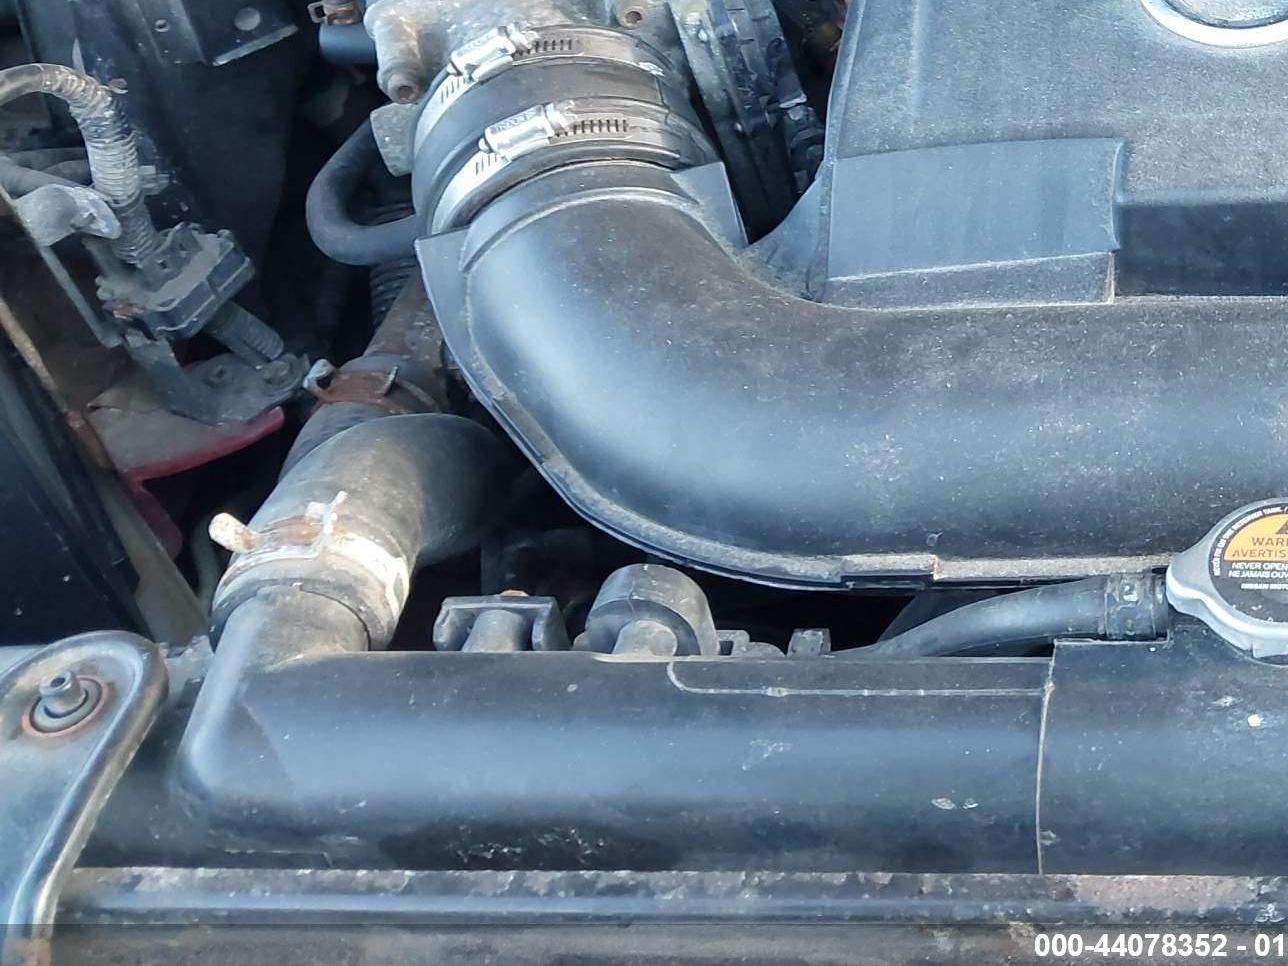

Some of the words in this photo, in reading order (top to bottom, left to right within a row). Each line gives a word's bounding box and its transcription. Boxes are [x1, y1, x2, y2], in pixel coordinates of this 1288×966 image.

[1231, 562, 1262, 570] NEVER
[1262, 563, 1288, 571] OPEN
[1228, 570, 1241, 578] NE
[1240, 570, 1270, 578] JAMAIS
